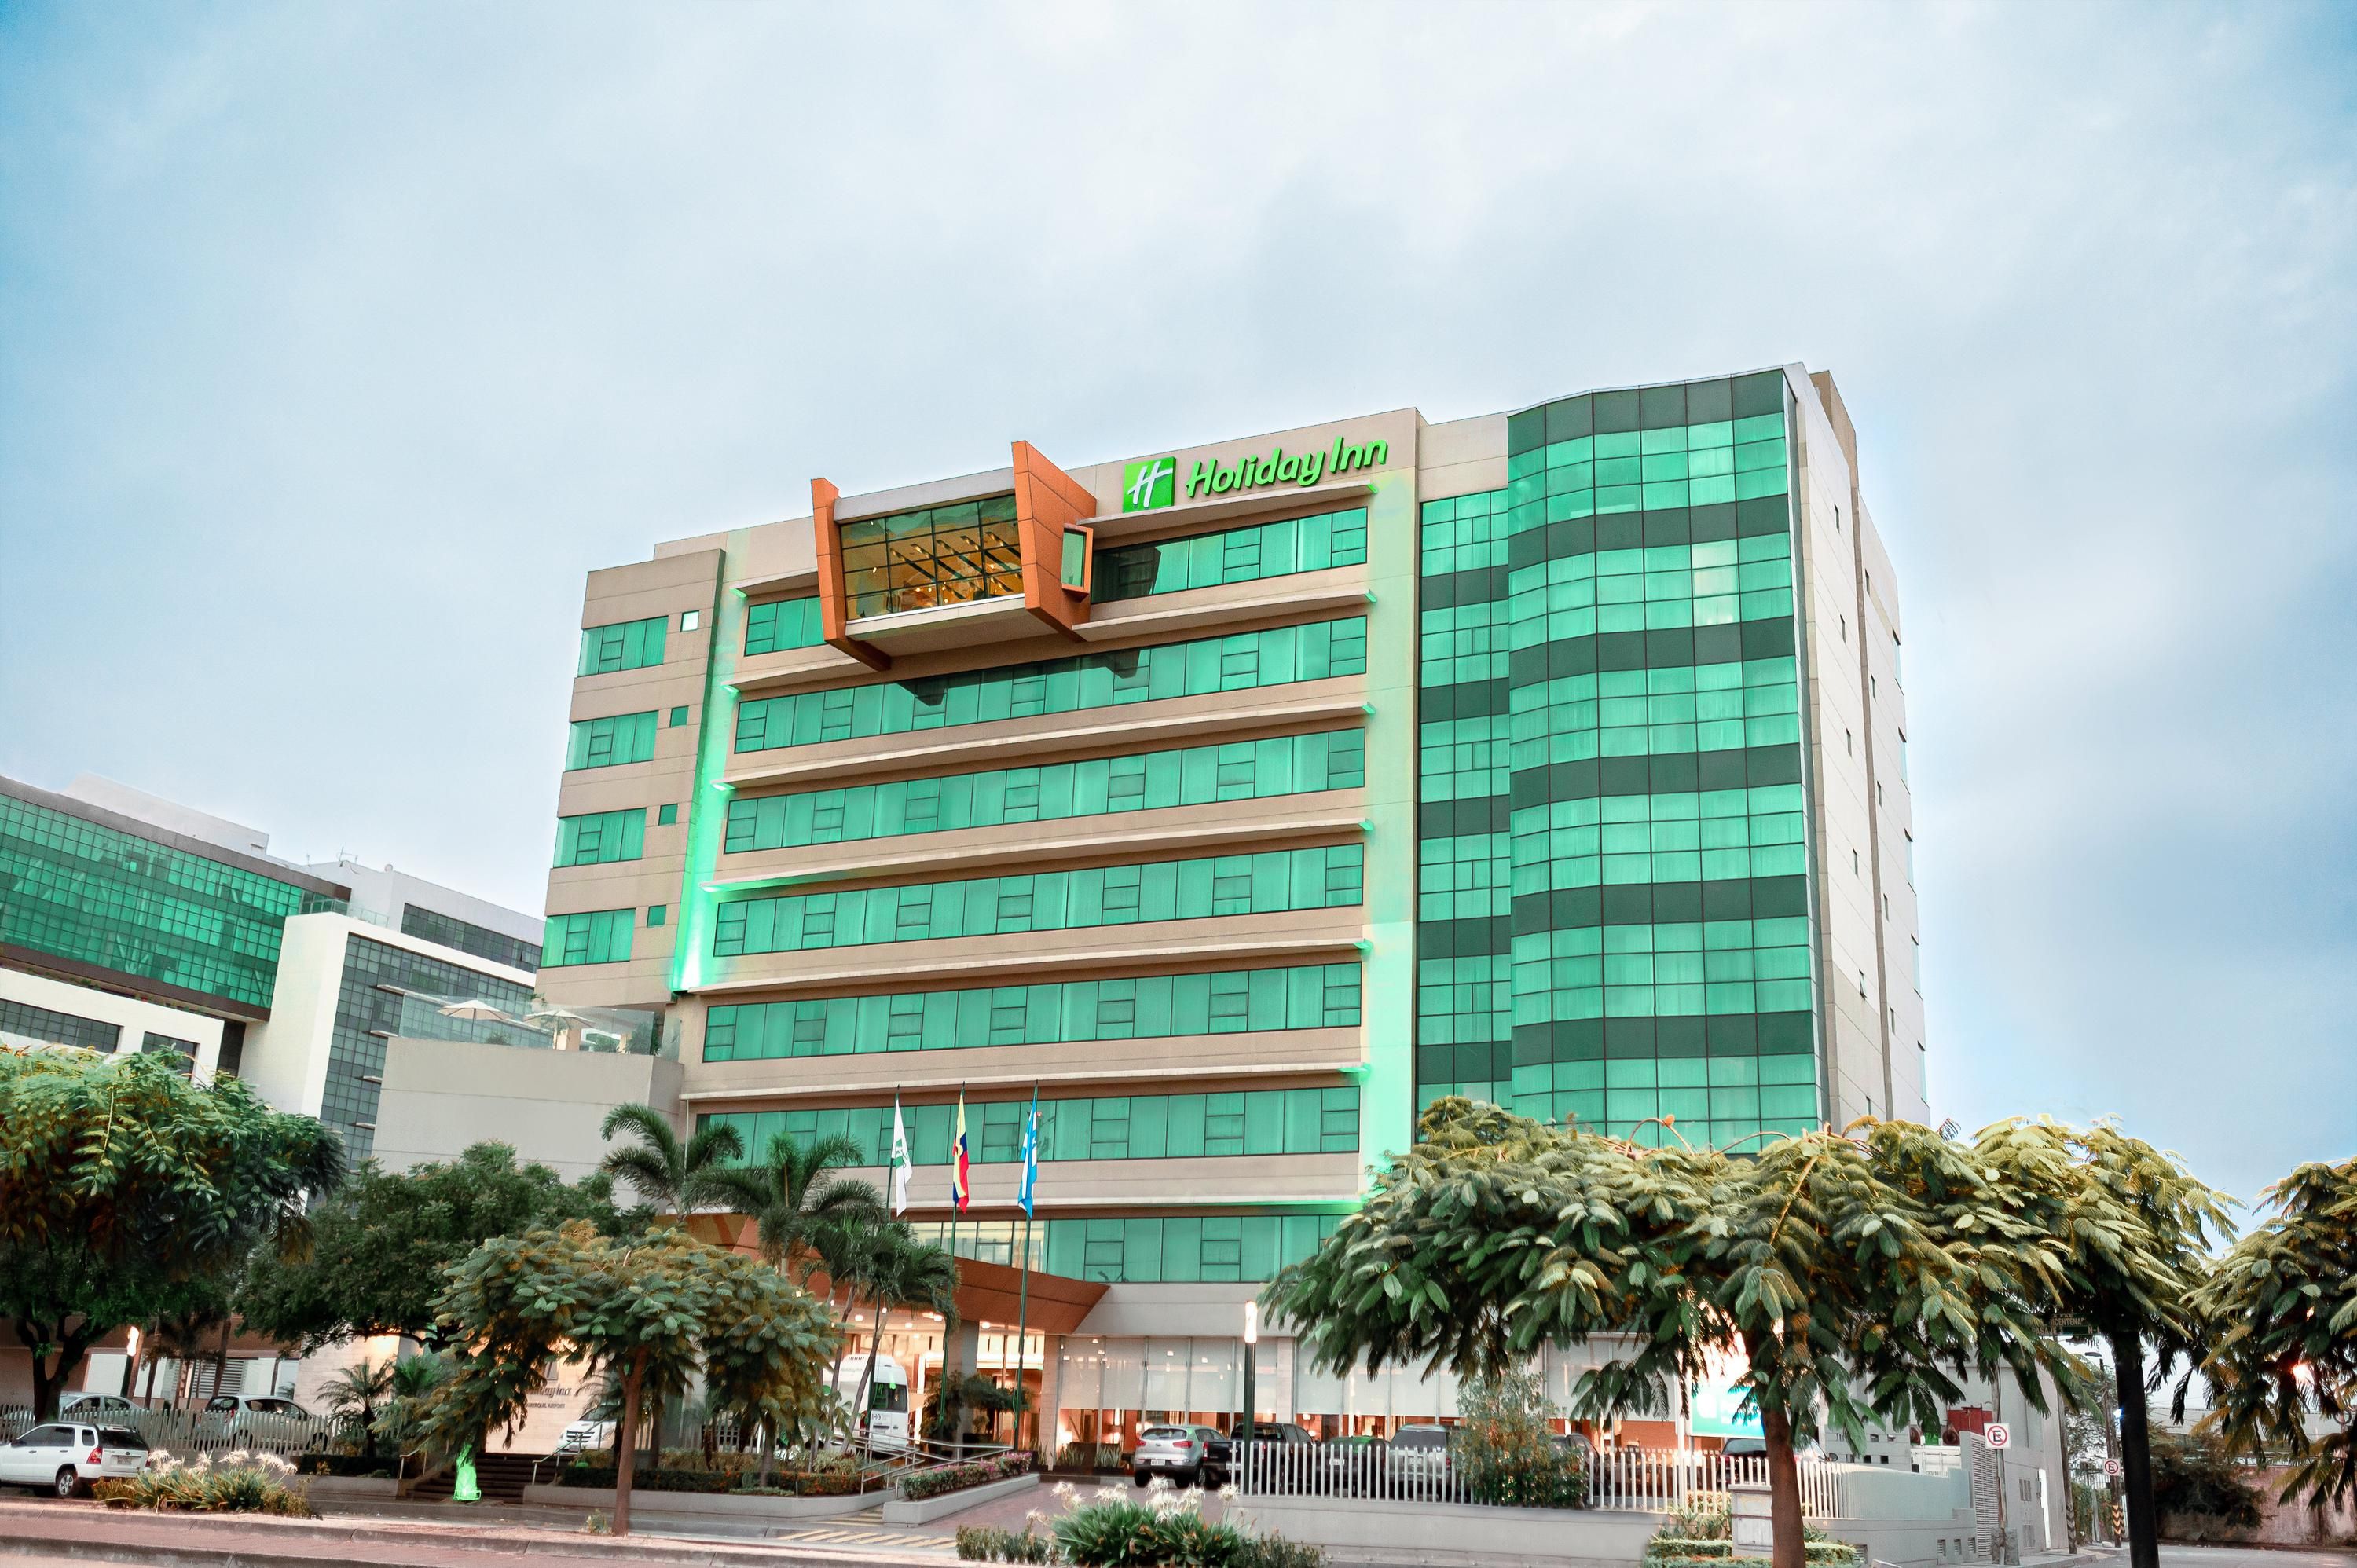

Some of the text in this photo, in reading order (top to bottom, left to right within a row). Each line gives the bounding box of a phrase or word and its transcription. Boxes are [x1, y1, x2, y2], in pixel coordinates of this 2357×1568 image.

[1186, 436, 1388, 498] Holiday Inn
[1992, 1430, 2001, 1442] E
